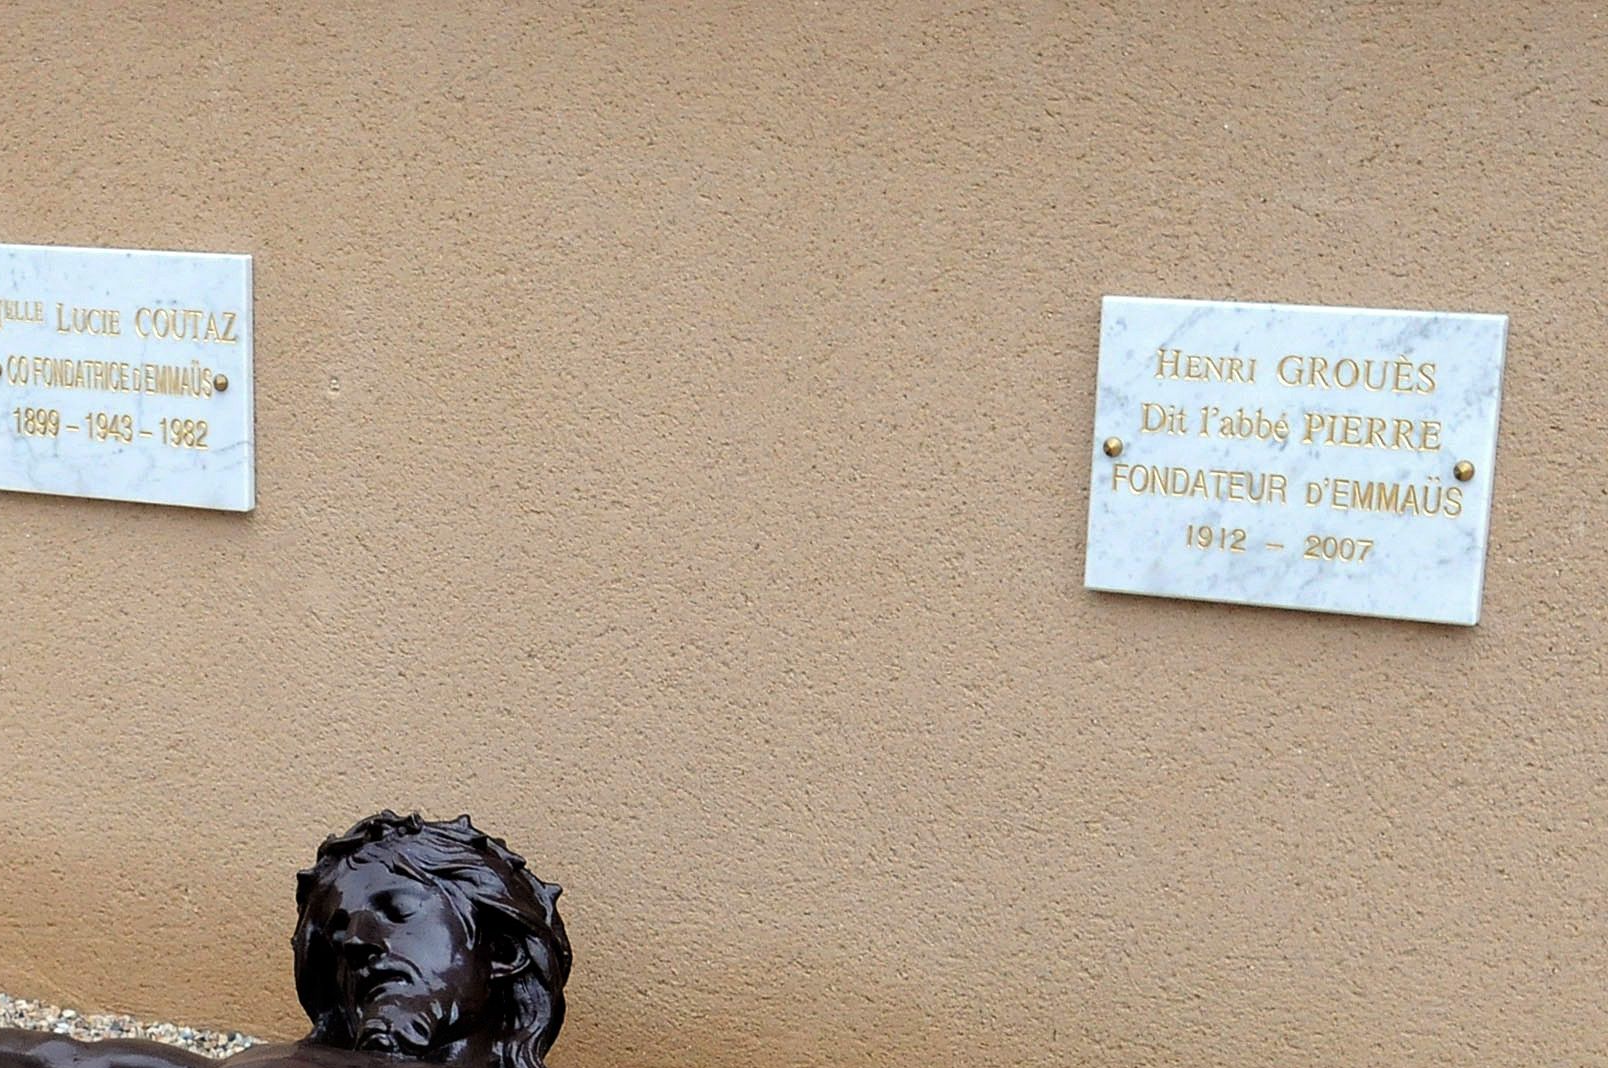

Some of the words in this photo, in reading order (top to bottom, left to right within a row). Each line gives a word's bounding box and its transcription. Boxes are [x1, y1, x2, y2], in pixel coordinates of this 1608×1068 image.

[55, 302, 122, 336] LUCIE
[135, 307, 239, 345] COUTAZ
[6, 354, 29, 385] CO
[33, 356, 130, 392] FONDATRICE
[1154, 347, 1258, 384] HENRI
[1275, 353, 1437, 395] GROUÈS
[12, 407, 60, 438] 1899
[85, 411, 134, 444] 1943
[158, 417, 209, 450] 1982
[1139, 402, 1189, 435] Dit
[1198, 403, 1290, 442] l'abbé
[1299, 412, 1443, 453] PIERRE
[1111, 462, 1288, 506] FONDATEUR
[1184, 524, 1248, 555] 1912
[1303, 534, 1376, 565] 2007
